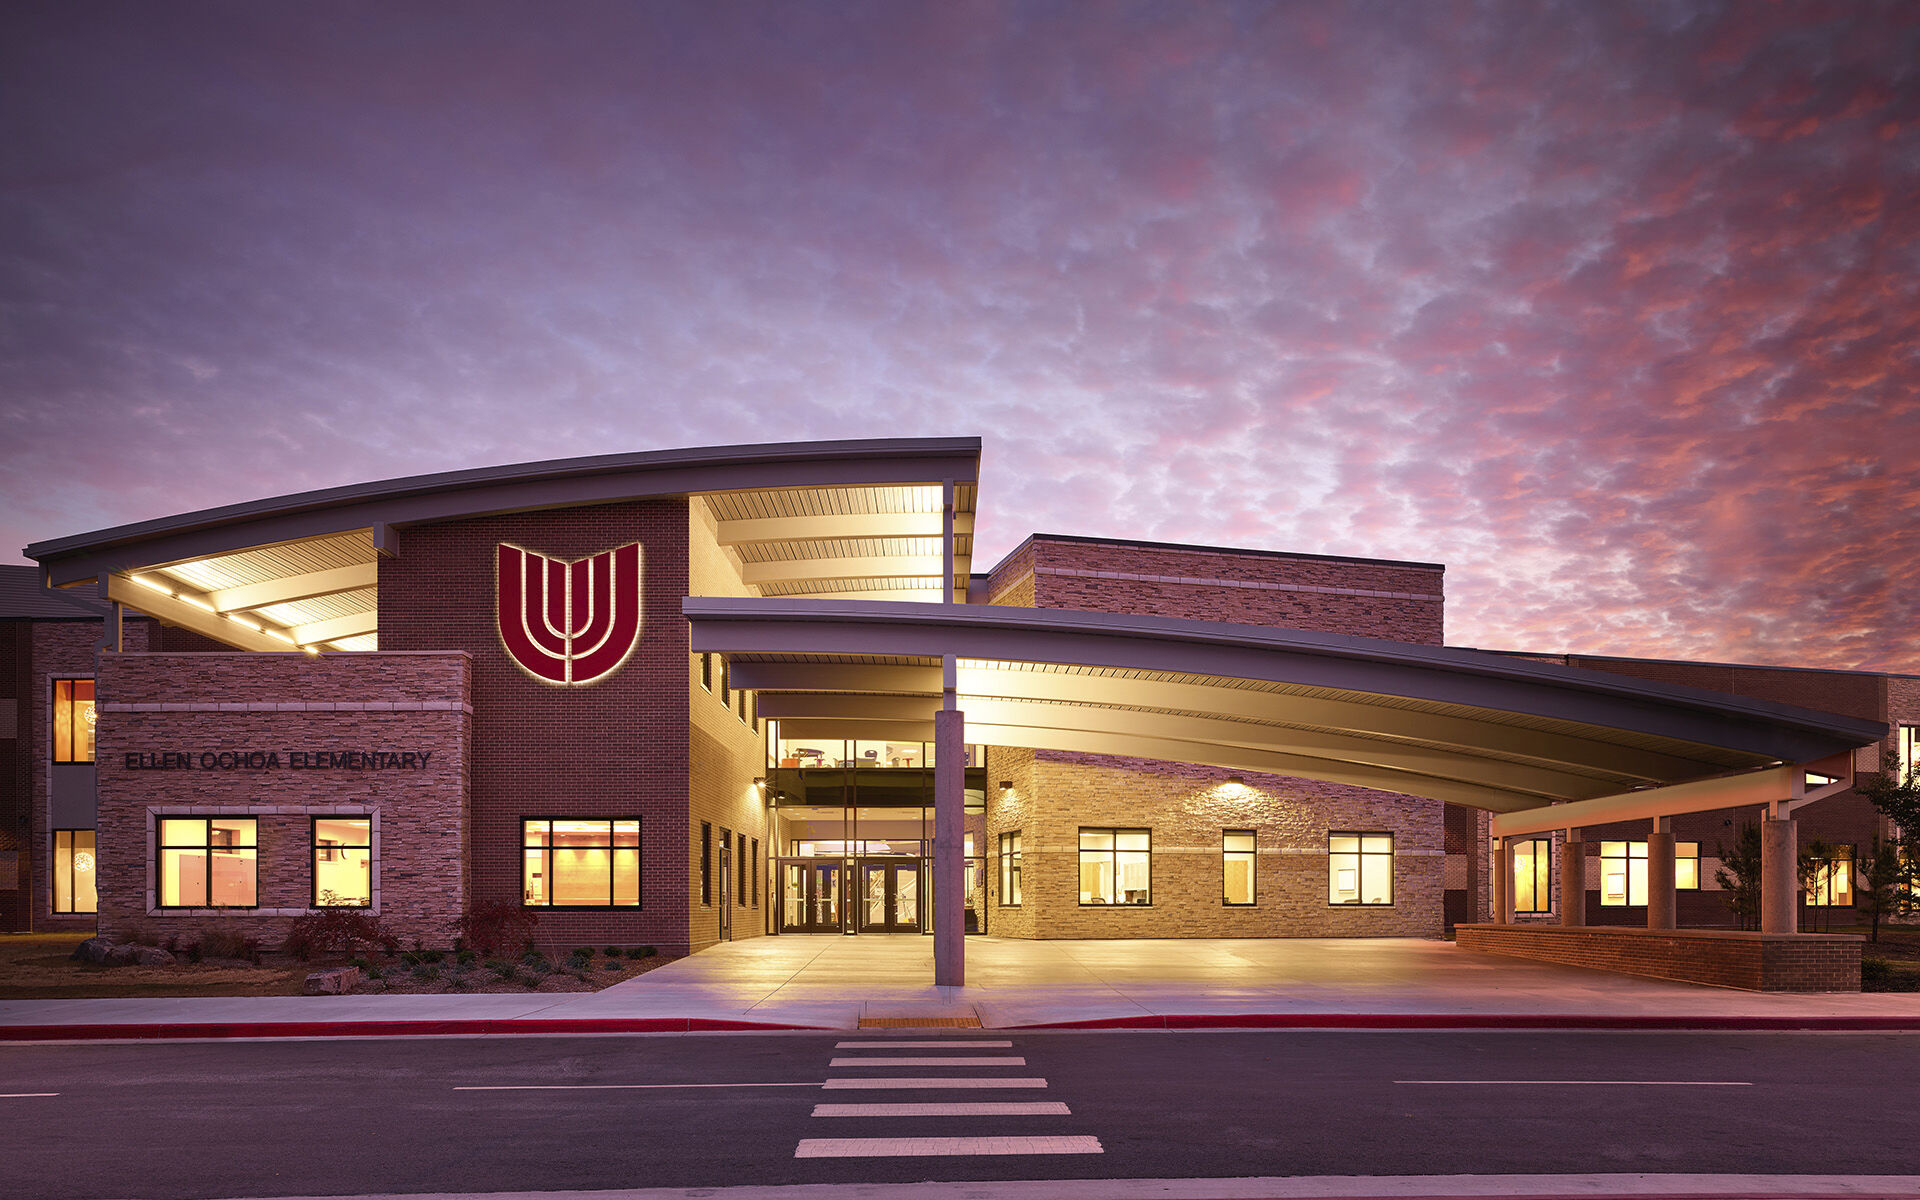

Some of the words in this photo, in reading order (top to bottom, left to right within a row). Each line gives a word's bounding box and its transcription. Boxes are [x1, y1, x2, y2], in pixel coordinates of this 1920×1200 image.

[125, 751, 191, 769] ELLEN
[200, 751, 280, 769] OCHOA
[289, 751, 431, 769] ELEMENTARY
